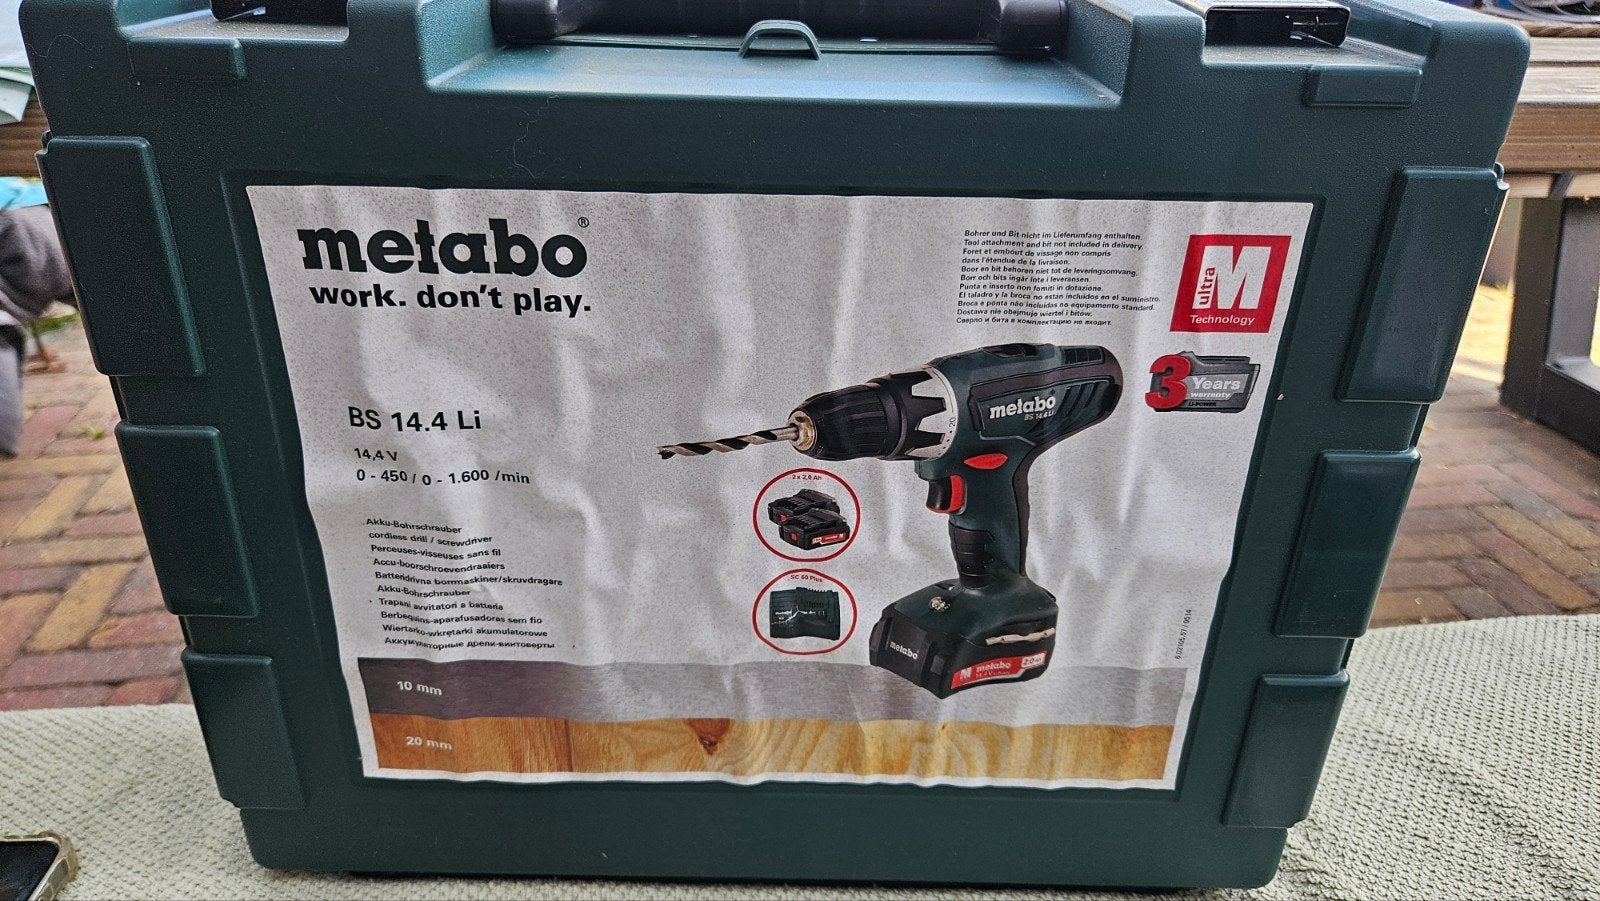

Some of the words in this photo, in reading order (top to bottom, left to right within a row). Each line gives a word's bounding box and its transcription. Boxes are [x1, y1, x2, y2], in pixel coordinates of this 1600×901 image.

[1054, 232, 1101, 240] Lieferumfang
[1104, 232, 1143, 240] enthalten.
[297, 218, 587, 278] metabo
[994, 248, 1023, 256] embout
[1112, 242, 1144, 250] delivery.
[1074, 268, 1138, 277] leveringsomvang.
[1192, 246, 1271, 309] M
[1198, 267, 1215, 305] ultra
[309, 284, 407, 307] work.
[416, 285, 503, 308] don't
[513, 288, 591, 318] play.
[1190, 315, 1255, 326] Technology
[1145, 354, 1191, 409] 3
[1192, 376, 1241, 390] Years
[990, 396, 1056, 419] metabo
[348, 406, 382, 430] BS
[391, 412, 448, 432] 14.4
[458, 410, 481, 429] Li
[949, 417, 956, 427] 20
[354, 448, 384, 462] 14,4
[387, 451, 398, 462] V
[357, 469, 365, 481] 0
[381, 470, 408, 482] 450
[412, 474, 416, 484] /
[422, 475, 431, 486] 0
[449, 470, 489, 484] 1.600
[495, 471, 530, 484] /min
[366, 518, 462, 533] Akku-Bohrschrauber
[369, 533, 407, 541] cordless
[410, 535, 427, 543] drill
[438, 537, 493, 547] screwdriver
[371, 545, 464, 560] Perceuses-visseuses
[467, 549, 489, 559] sans
[373, 558, 505, 573] Accu-boorschroevendraaiers
[378, 585, 471, 598] Akku-Bohrschrauber
[379, 598, 411, 608] Trapani
[476, 628, 548, 637] akumulatorowe
[890, 642, 918, 660] metabo
[976, 661, 1011, 672] metabo
[397, 681, 412, 691] 10
[417, 684, 442, 696] mm
[406, 736, 422, 746] 20
[427, 740, 452, 751] mm
